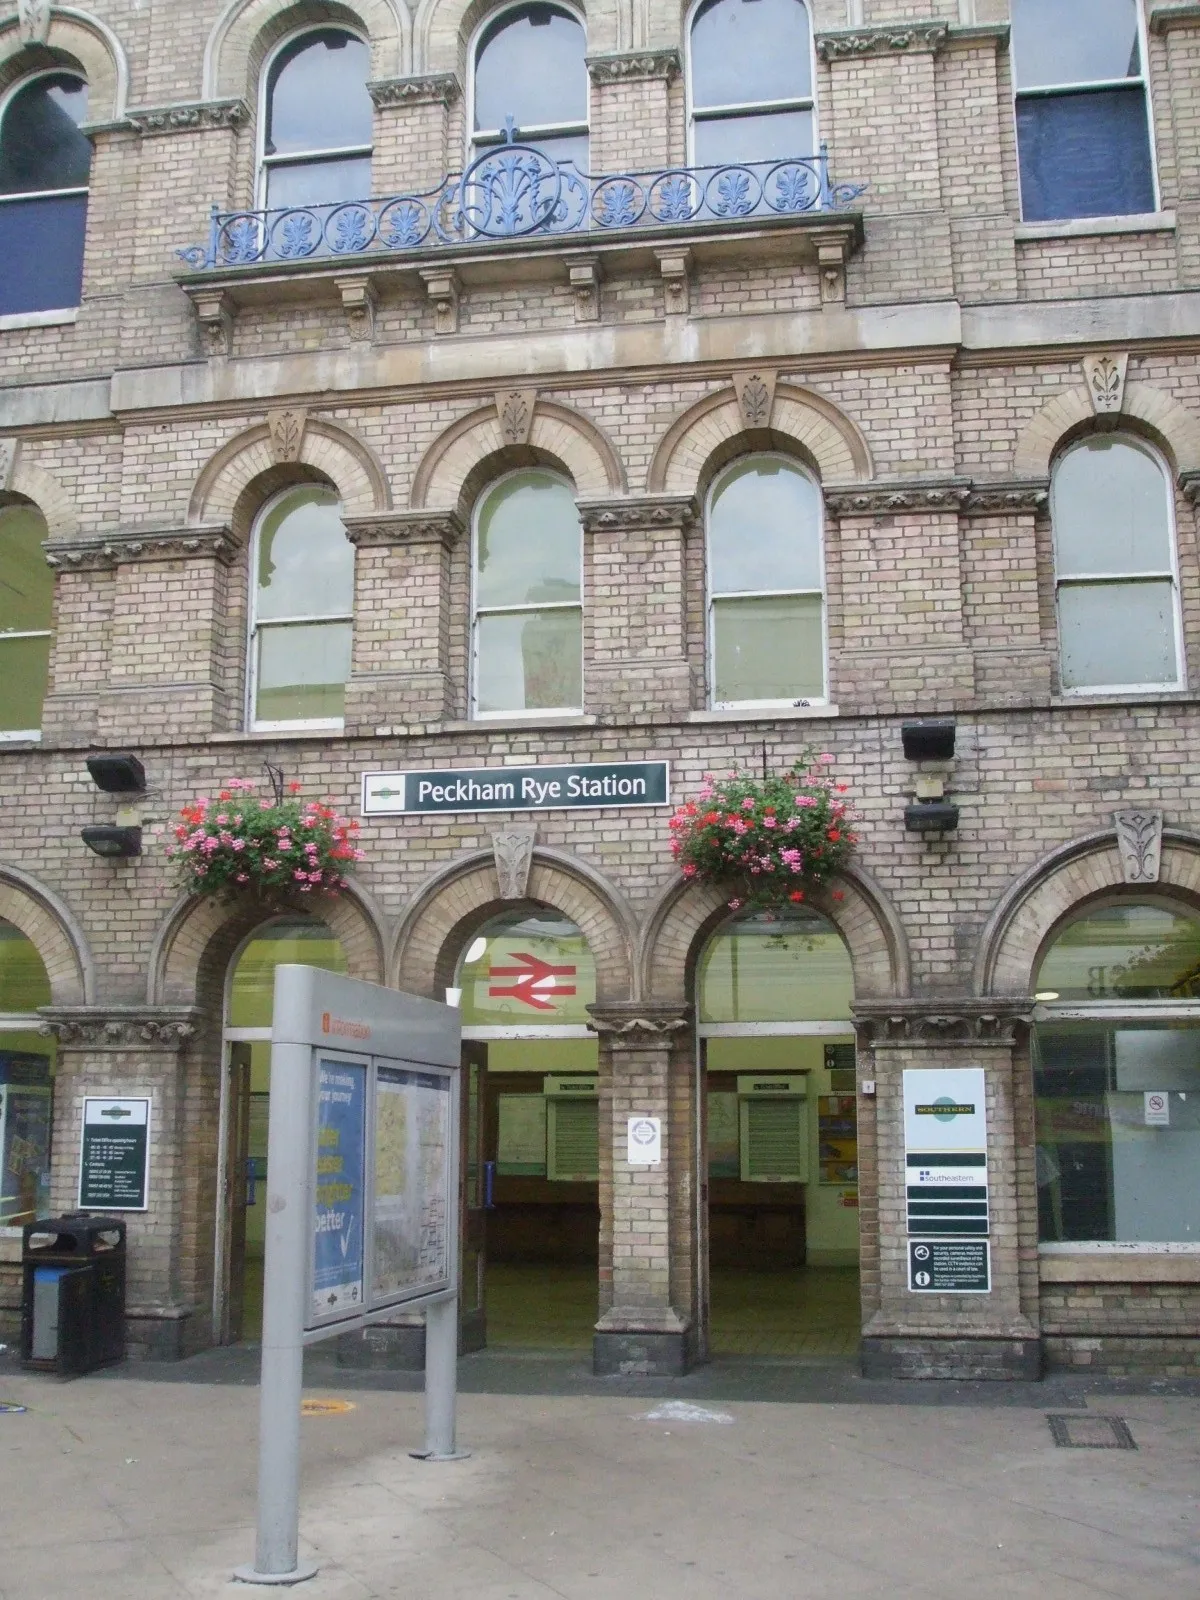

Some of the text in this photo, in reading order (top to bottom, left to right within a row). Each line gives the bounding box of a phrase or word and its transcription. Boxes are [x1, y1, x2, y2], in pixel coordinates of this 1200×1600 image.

[418, 773, 646, 804] Peckham Rye Station
[925, 1174, 974, 1182] southeastern
